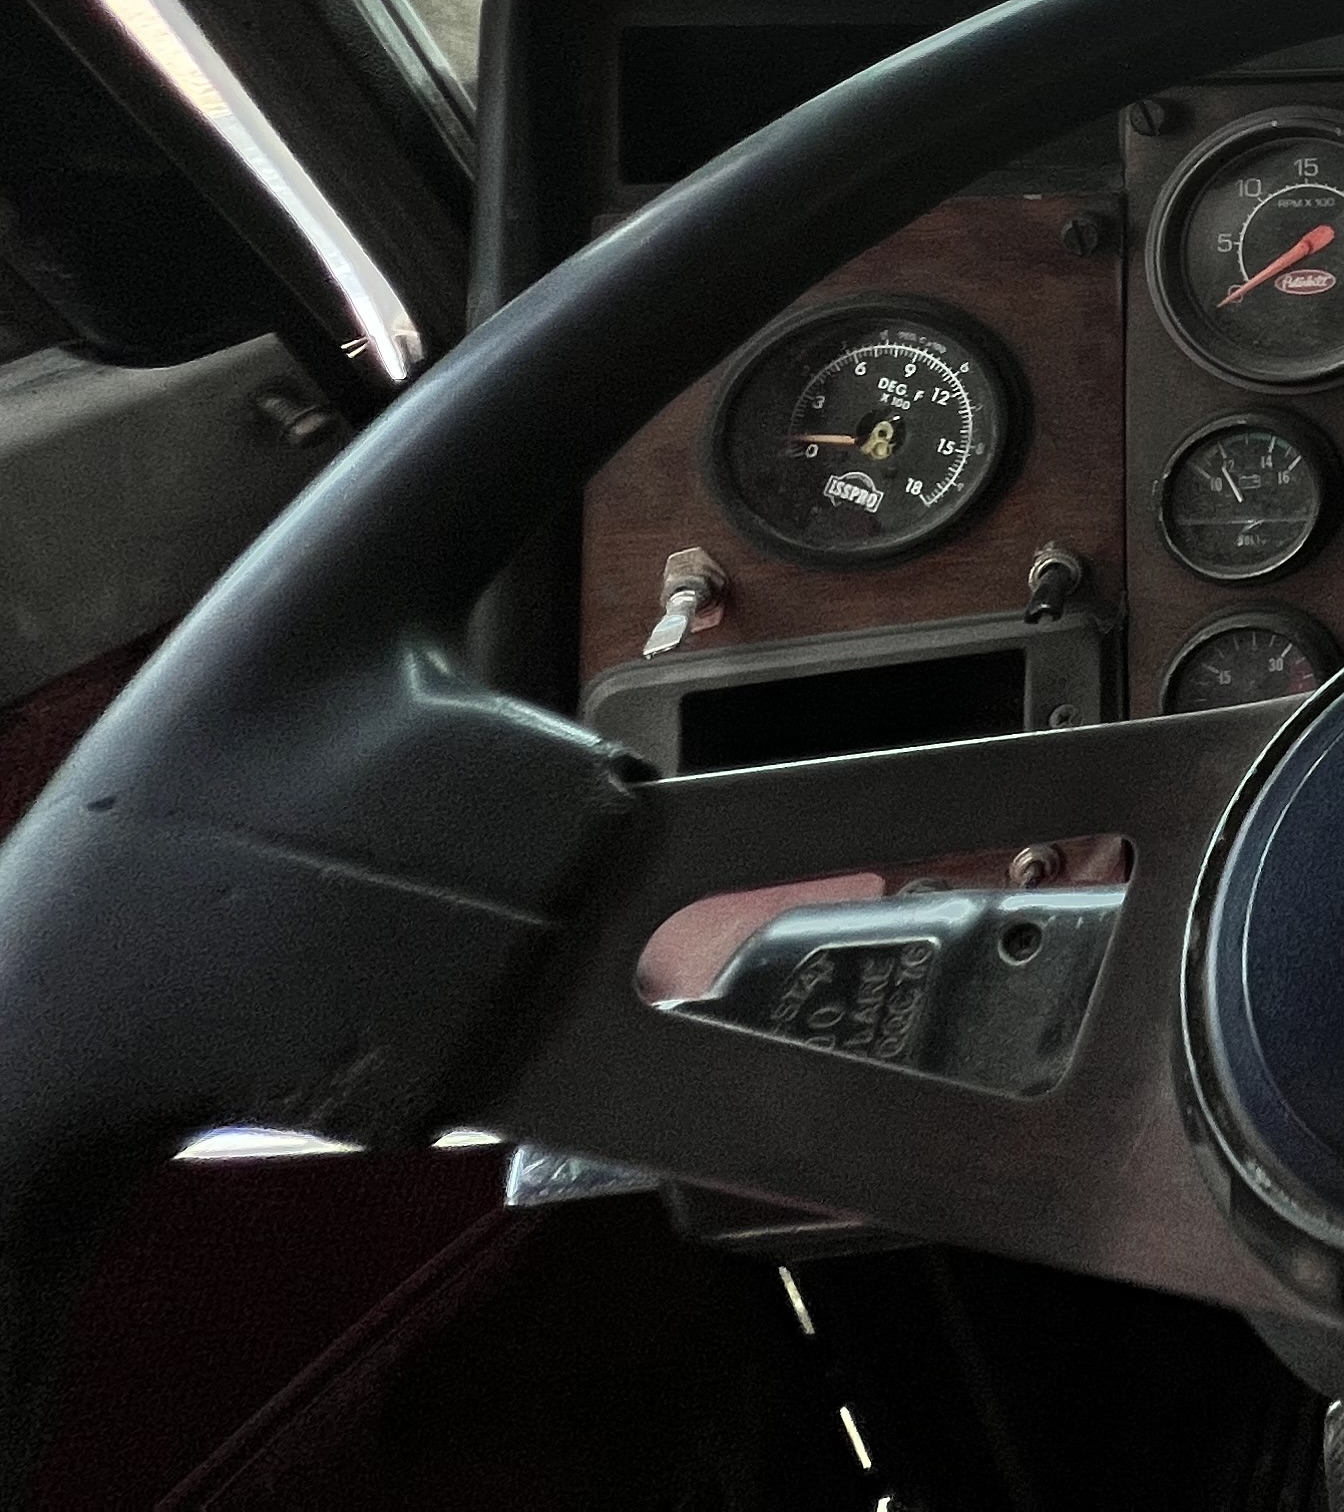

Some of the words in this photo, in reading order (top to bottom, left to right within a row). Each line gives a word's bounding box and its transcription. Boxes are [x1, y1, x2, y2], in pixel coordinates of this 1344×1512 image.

[1294, 158, 1319, 177] 15
[1236, 178, 1262, 199] 10
[1278, 199, 1302, 208] RPM
[1305, 198, 1312, 207] X
[1315, 197, 1335, 207] 100
[1216, 233, 1233, 253] 5
[855, 362, 868, 376] 6
[904, 363, 917, 378] 9
[959, 361, 970, 373] 6
[812, 395, 826, 410] 3
[890, 396, 911, 410] 100
[913, 390, 925, 402] F
[931, 387, 951, 406] 12
[805, 443, 819, 459] 0
[937, 437, 957, 456] 15
[1260, 455, 1273, 469] 14
[1277, 470, 1290, 485] 16
[905, 477, 924, 495] 18
[827, 479, 879, 509] ISSPRO
